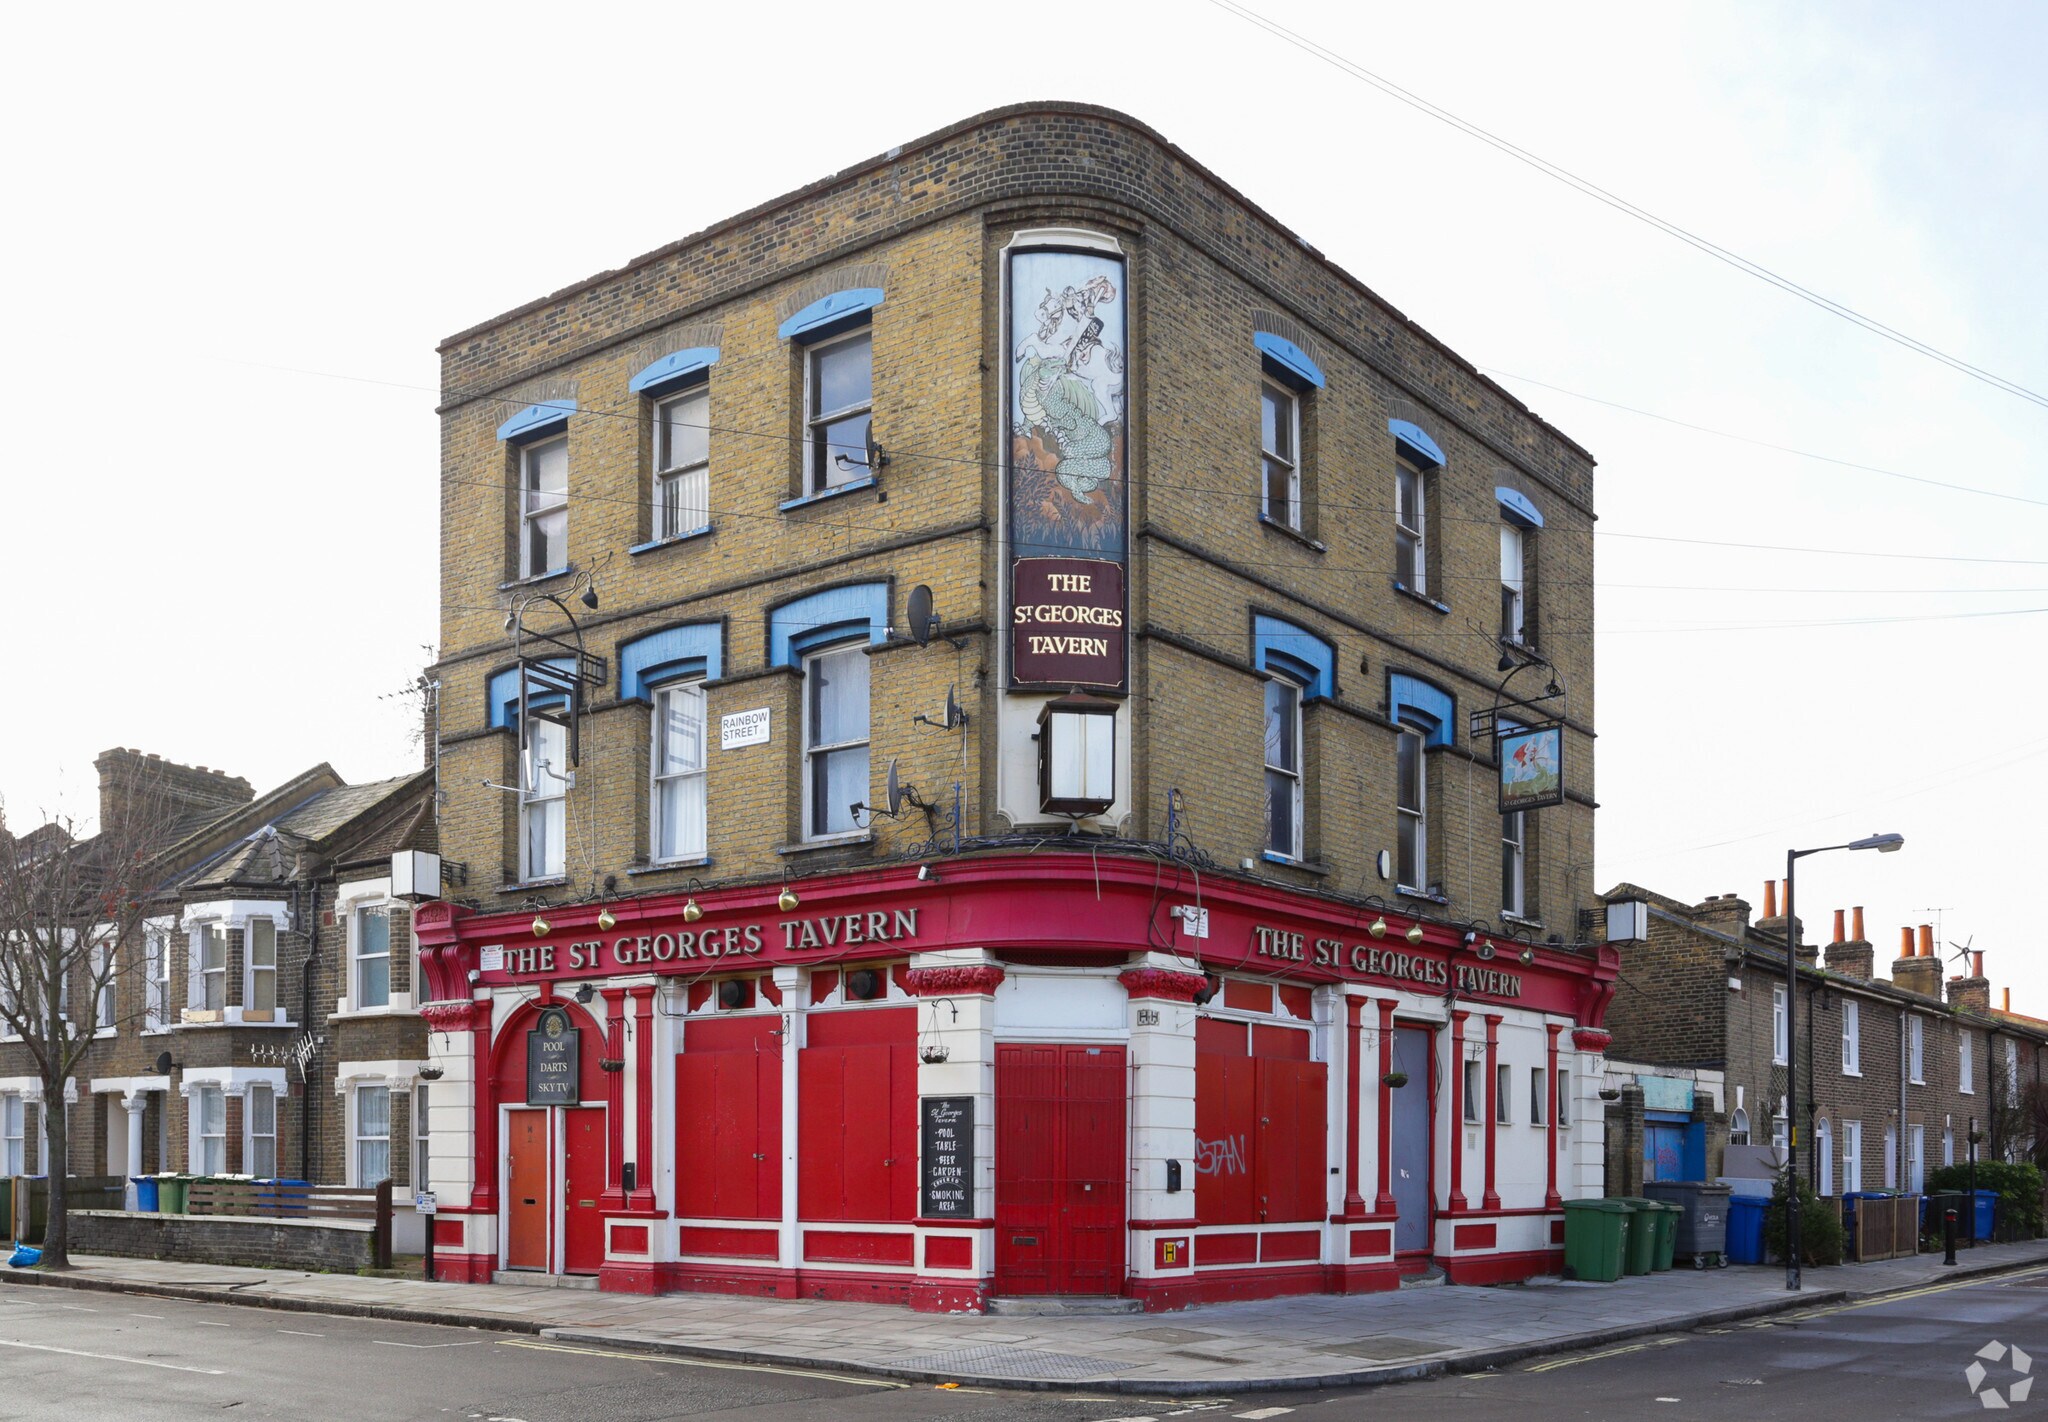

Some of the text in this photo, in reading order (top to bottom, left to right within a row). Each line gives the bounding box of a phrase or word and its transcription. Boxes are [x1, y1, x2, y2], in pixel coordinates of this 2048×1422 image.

[1048, 574, 1091, 593] THE
[1035, 605, 1122, 627] GEORGES
[1029, 636, 1108, 657] TAVERN
[723, 712, 768, 729] RAINBOW
[723, 725, 759, 741] STREET
[1537, 792, 1558, 801] TAVERN
[503, 946, 556, 974] THE
[569, 940, 603, 969] ST
[613, 925, 762, 965] GEORGES
[779, 908, 918, 949] TAVERN
[1256, 926, 1522, 998] THE ST GEORGES TAVERN
[543, 1041, 565, 1052] POOL
[540, 1062, 568, 1072] DARTS
[538, 1082, 569, 1093] SKY TV
[934, 1115, 957, 1123] Tavern
[938, 1128, 955, 1138] POOL
[935, 1141, 957, 1151] TABLE
[939, 1155, 955, 1165] BEER
[1195, 1135, 1246, 1177] STAN
[932, 1166, 962, 1176] GARDEN
[931, 1190, 965, 1200] SMOKING
[938, 1201, 956, 1211] AREA
[1165, 1244, 1175, 1261] H
